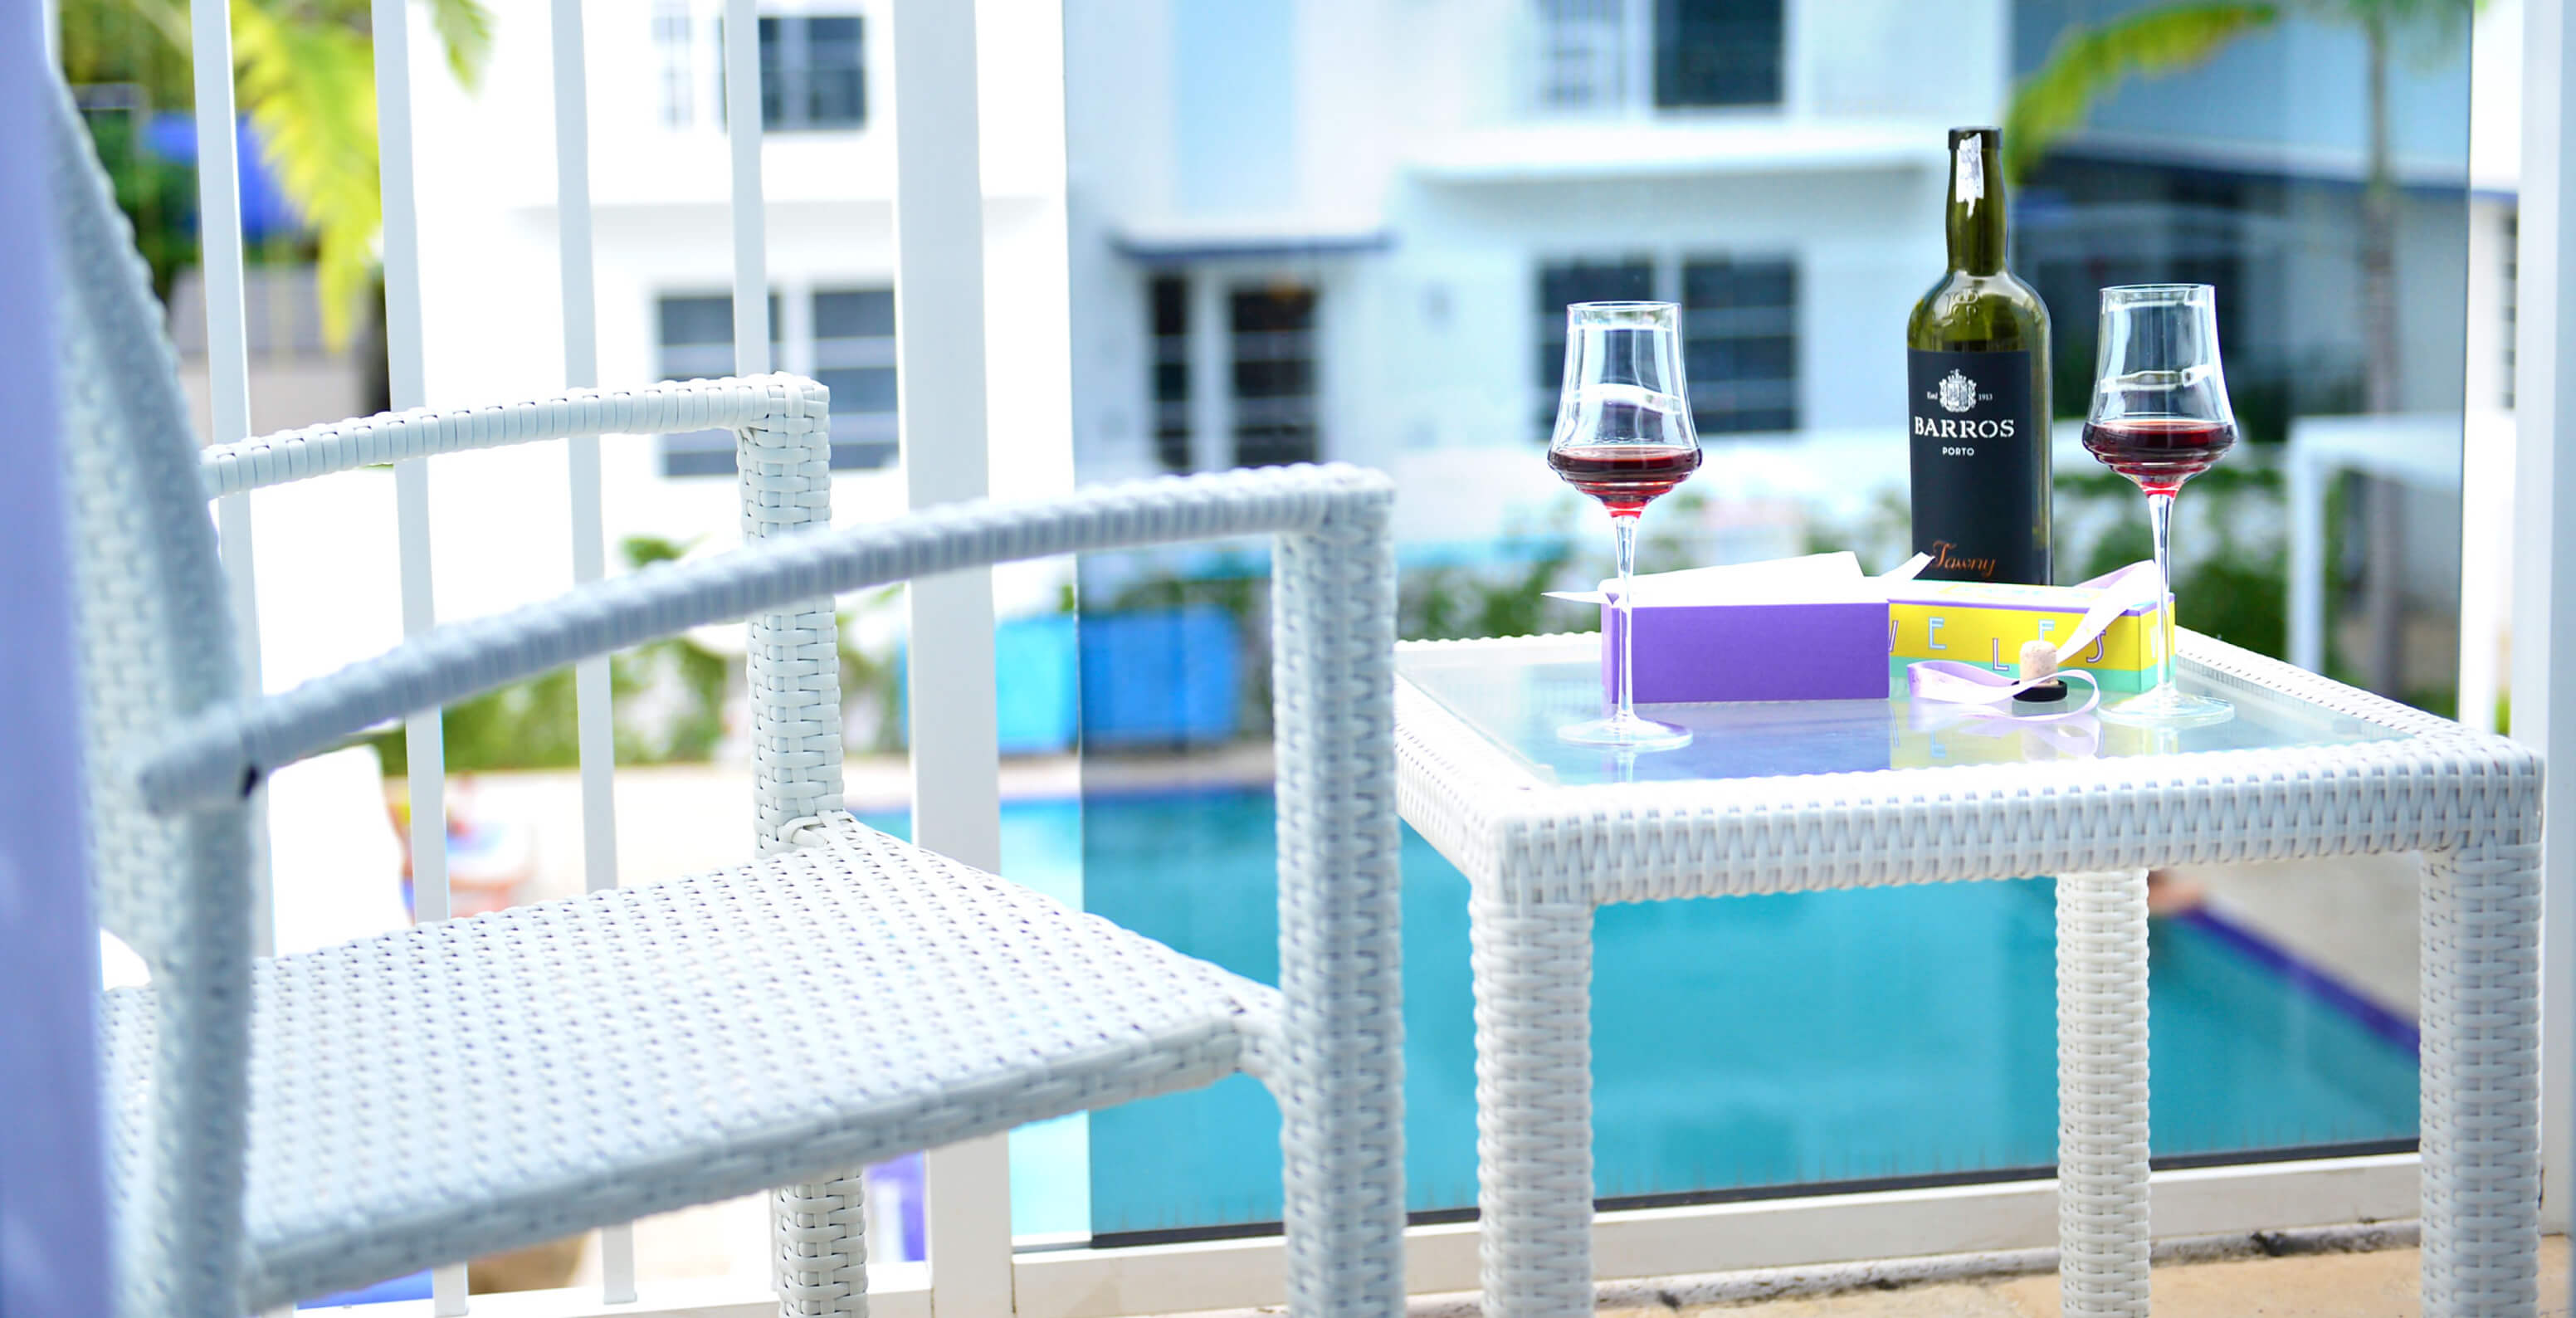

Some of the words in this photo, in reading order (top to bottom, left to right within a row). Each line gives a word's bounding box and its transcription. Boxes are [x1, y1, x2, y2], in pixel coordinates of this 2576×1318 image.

[1914, 416, 2015, 439] BARROS
[1942, 446, 1975, 456] PORTO
[1932, 539, 1996, 578] Tawny
